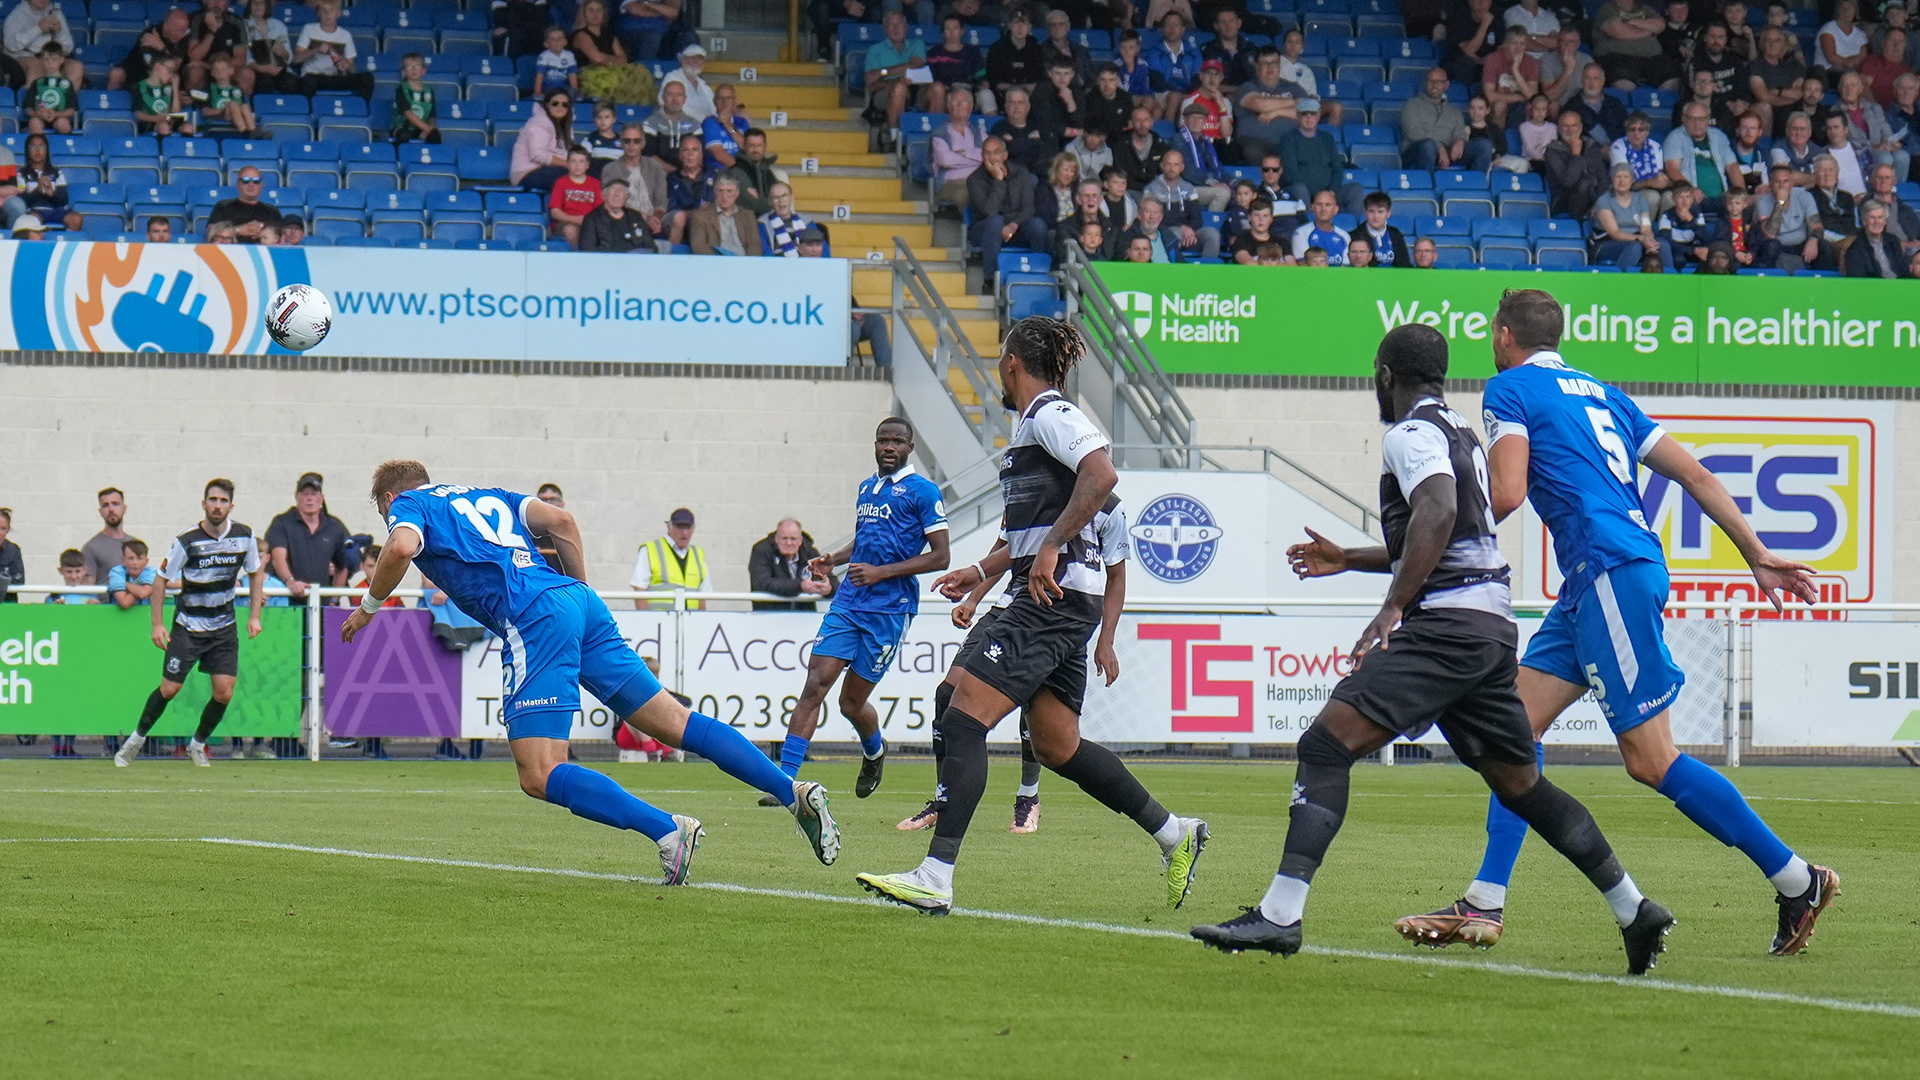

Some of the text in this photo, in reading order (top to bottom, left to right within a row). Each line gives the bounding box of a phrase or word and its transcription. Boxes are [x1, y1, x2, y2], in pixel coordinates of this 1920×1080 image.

[714, 39, 724, 50] H
[743, 69, 754, 80] G
[775, 114, 783, 124] F
[806, 159, 815, 171] E
[836, 206, 847, 218] D
[334, 287, 824, 327] www.ptscompliance.co.uk
[1161, 293, 1256, 317] Nuffield
[1161, 318, 1240, 343] Health
[1564, 303, 1660, 353] lding
[1671, 315, 1694, 344] a
[1707, 306, 1882, 347] healthier
[1584, 405, 1633, 485] 5
[450, 495, 529, 550] 12
[1145, 499, 1208, 523] EASTLEIGH
[1141, 544, 1188, 579] FOOTBALL
[1192, 545, 1212, 572] CLUB
[1263, 646, 1352, 677] Towb
[1267, 683, 1333, 704] Hampshir
[1585, 663, 1606, 700] 5
[522, 696, 557, 707] Matrix IT
[1267, 715, 1293, 730] Tel.
